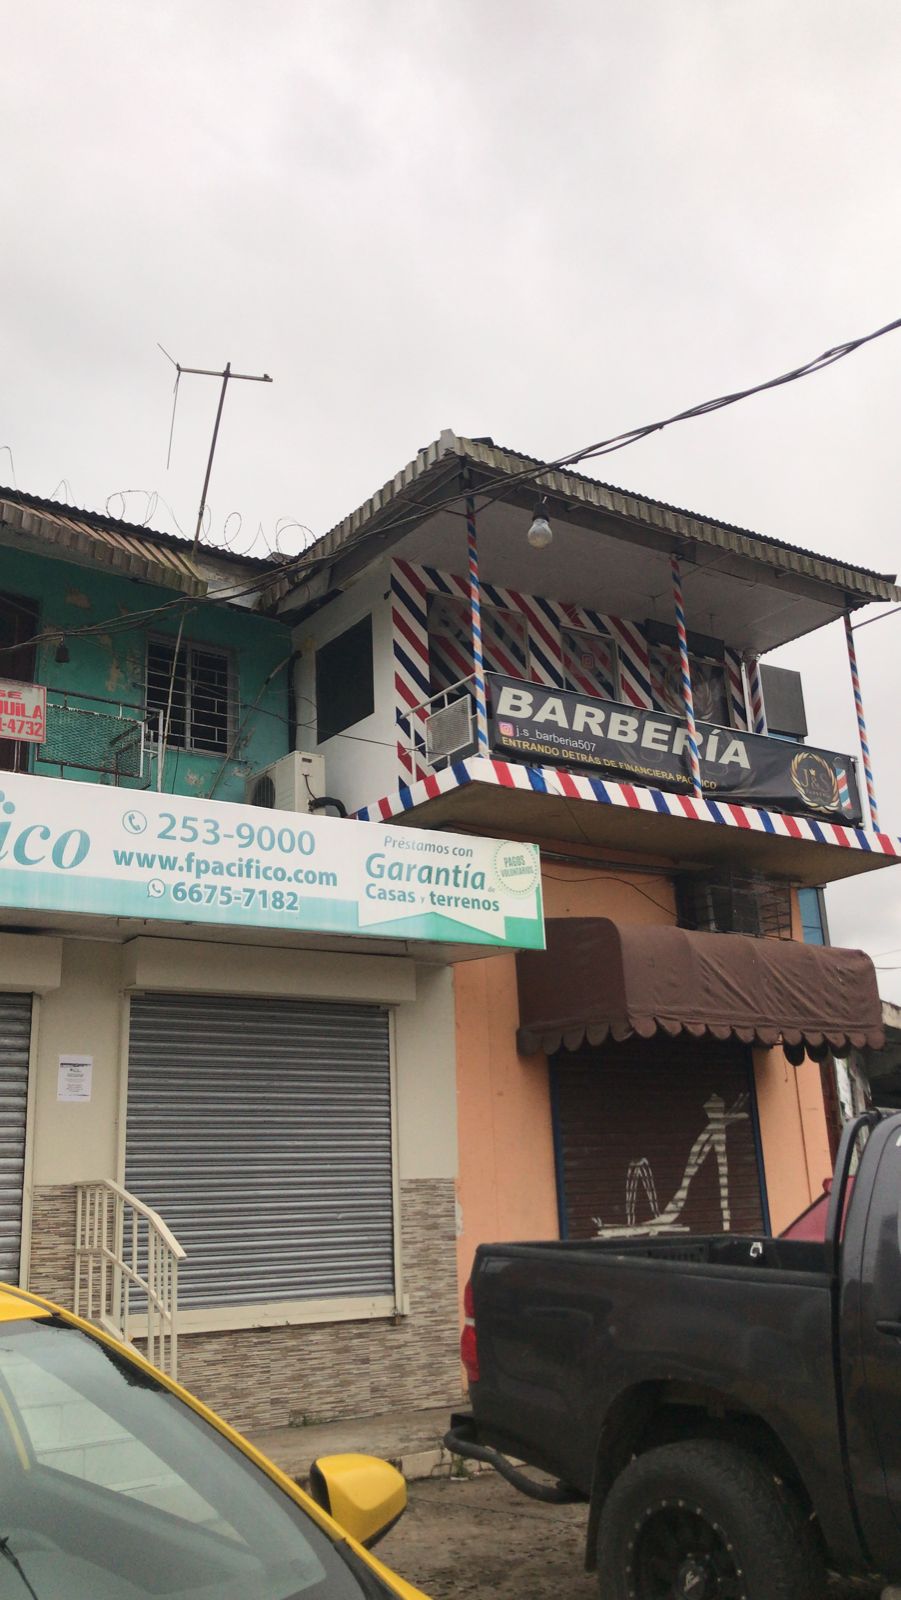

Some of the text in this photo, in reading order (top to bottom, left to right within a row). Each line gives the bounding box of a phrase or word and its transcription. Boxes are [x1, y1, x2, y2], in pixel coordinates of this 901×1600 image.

[496, 686, 751, 770] BARBERÍA
[515, 725, 597, 752] j.s_barberia507
[502, 737, 716, 789] ENTRANDO DETRÁS DE FINANCIERA PACICO
[0, 790, 91, 870] ico
[156, 812, 316, 856] 253-9000
[384, 835, 474, 858] Préstamos con
[112, 849, 338, 887] www.fpacifico.com
[365, 852, 486, 890] Garantía
[171, 881, 300, 911] 6675-7182
[365, 883, 416, 903] Casas
[429, 890, 500, 912] terrenos
